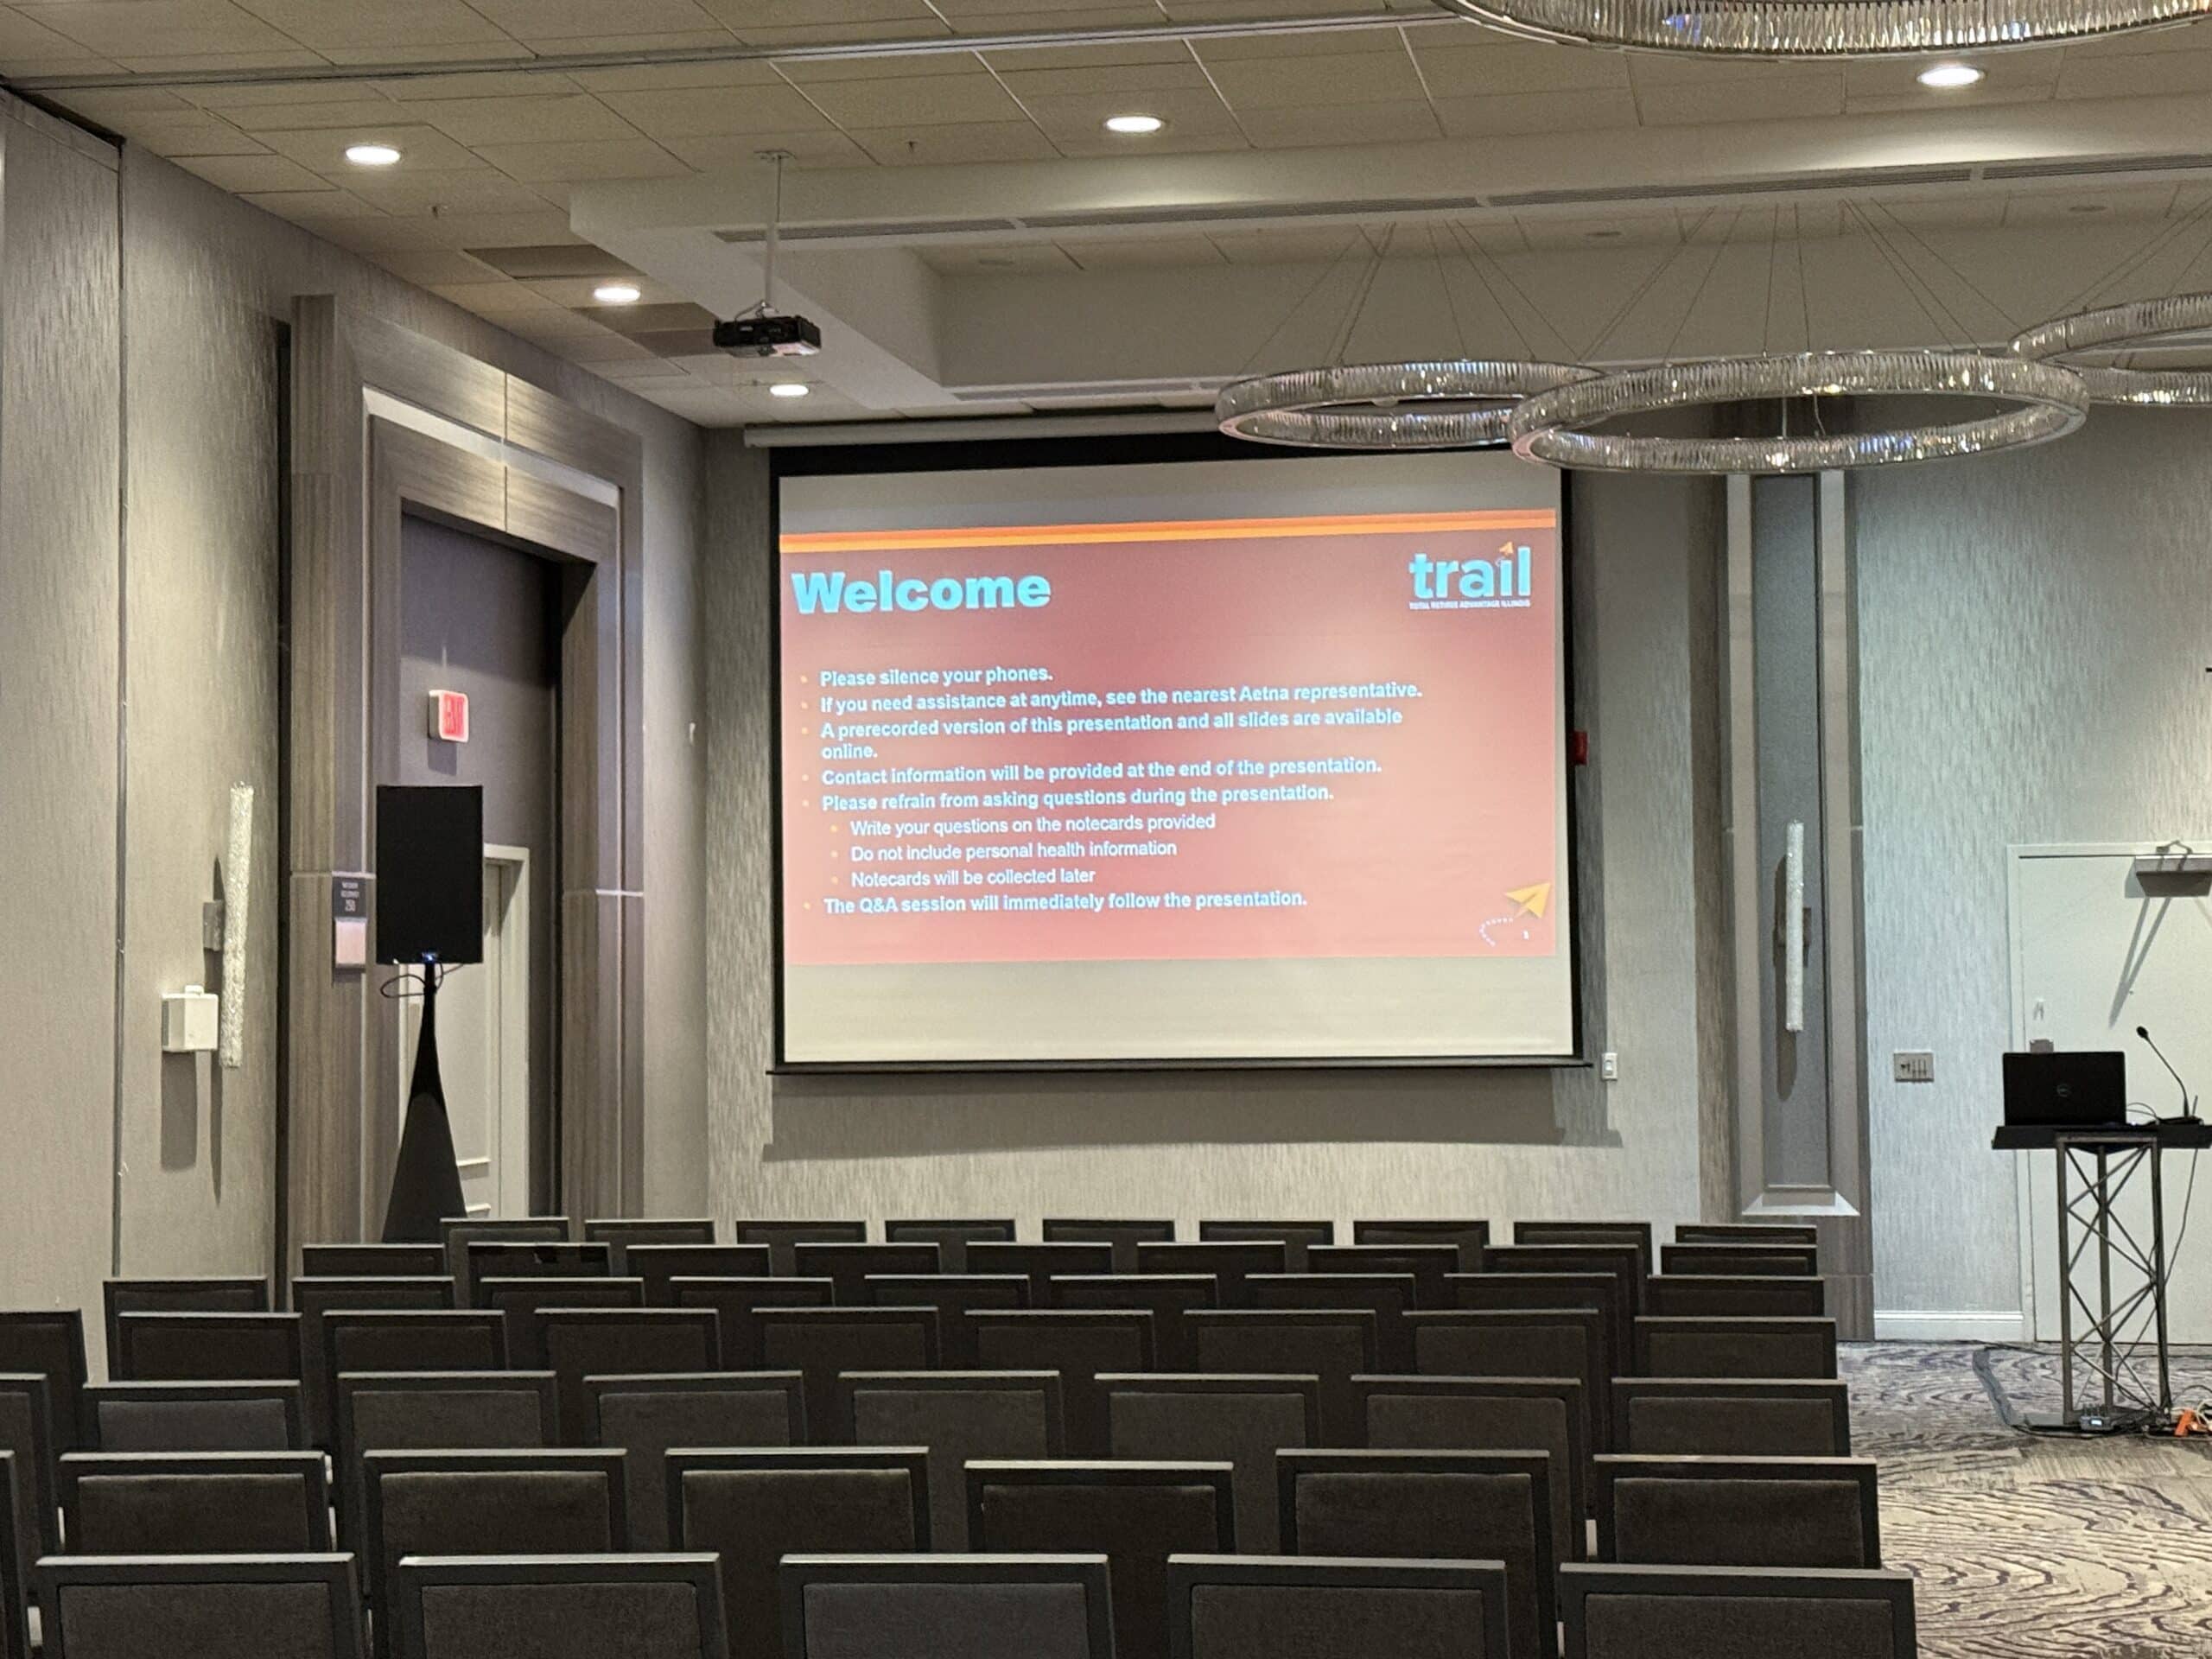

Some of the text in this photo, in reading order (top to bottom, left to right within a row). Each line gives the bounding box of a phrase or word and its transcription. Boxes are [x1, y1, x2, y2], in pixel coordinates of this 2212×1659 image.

[1408, 545, 1530, 599] trail
[791, 570, 1052, 613] Welcome
[820, 665, 1053, 687] Please silence your phones.
[821, 682, 1422, 715] If you need assistance at anytime, see the nearest Aetna representative.
[820, 708, 1402, 741] A prerecorded version of this presentation and all slides are available
[821, 743, 878, 760] online.
[821, 756, 1382, 785] Contact information will be provided at the end of the presentation.
[822, 785, 1334, 811] Please refrain from asking questions during the presentation.
[850, 813, 1216, 838] Write your questions on the notecards provided
[851, 840, 1177, 862] Do not include personal health information
[851, 868, 1096, 887] Notecards will be collected later
[823, 890, 1307, 913] The Q&A session will immediately follow the presentation.
